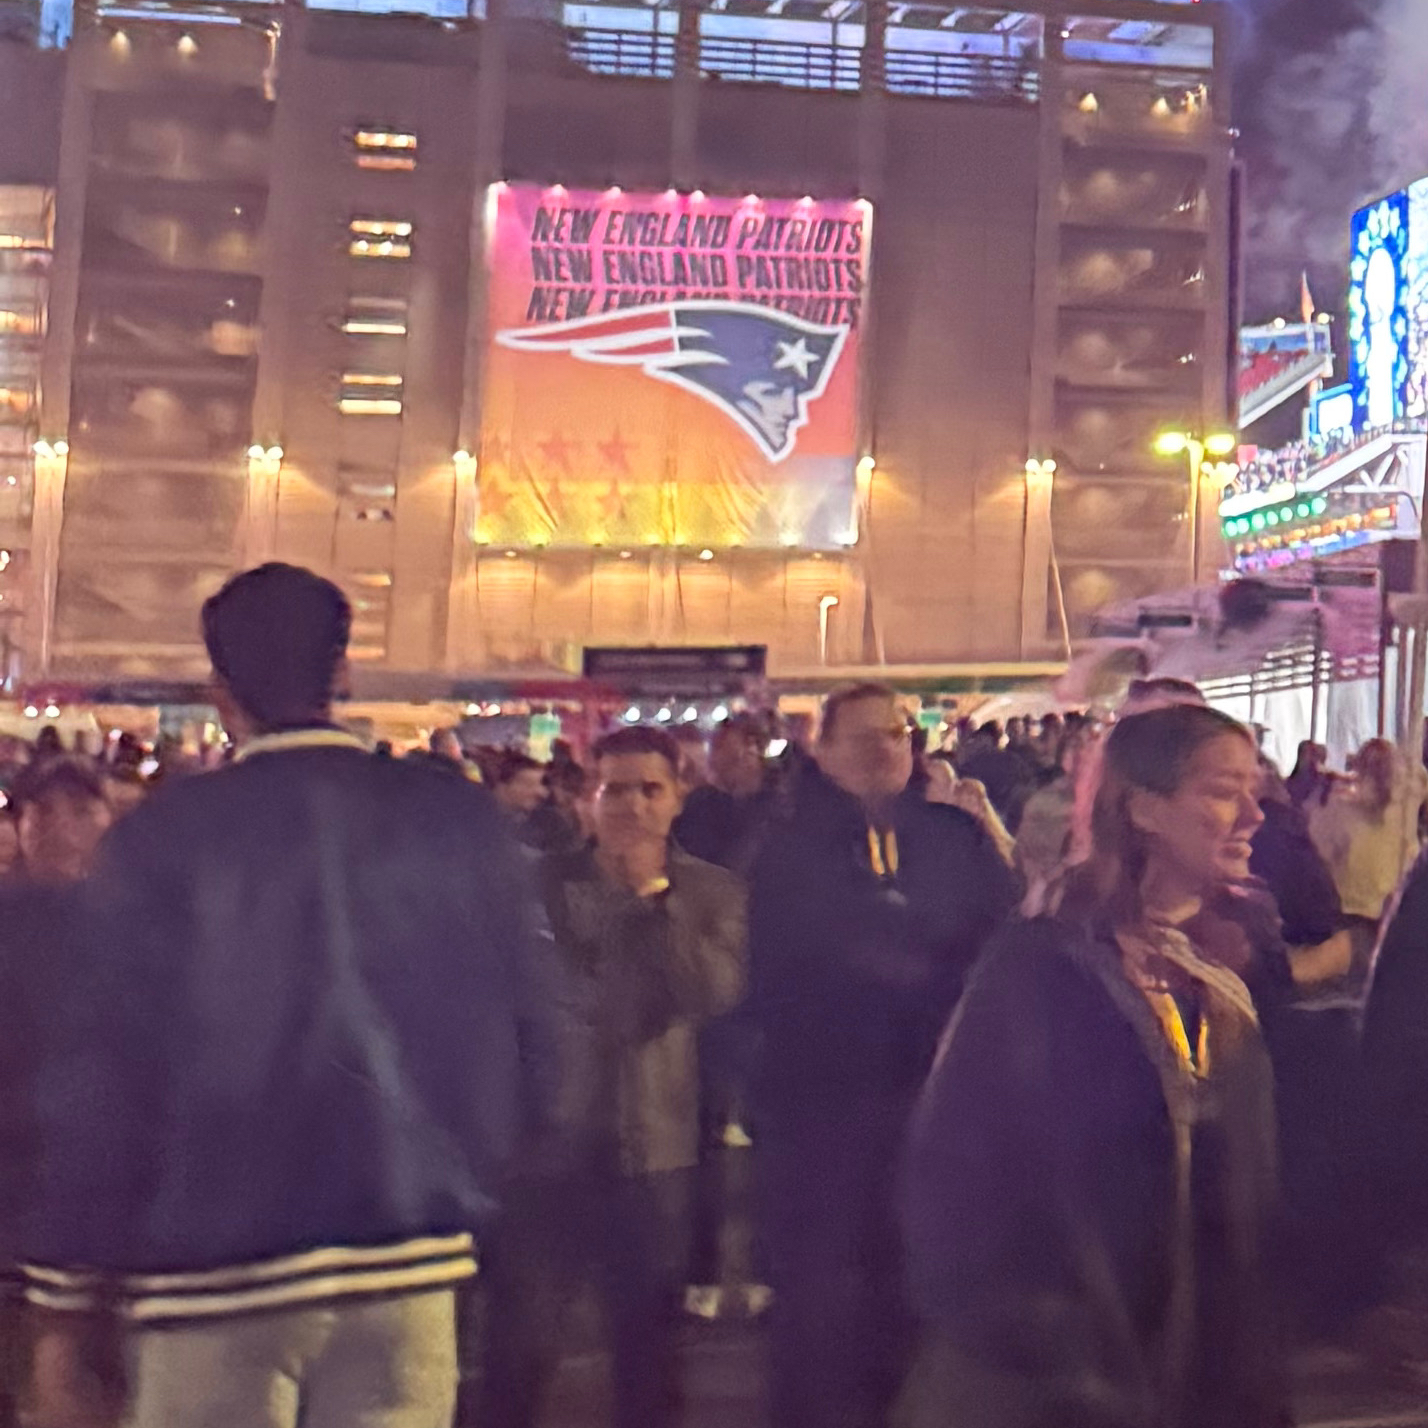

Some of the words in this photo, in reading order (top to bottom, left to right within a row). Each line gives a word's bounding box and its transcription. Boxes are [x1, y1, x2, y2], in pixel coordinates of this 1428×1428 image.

[532, 207, 600, 244] NEW
[603, 211, 731, 249] ENGLAND
[736, 216, 863, 255] PATRIOTS
[532, 246, 592, 283] NEW
[603, 250, 728, 287] ENGLAND
[736, 255, 862, 293] PATRIOTS
[526, 287, 595, 322] NEW
